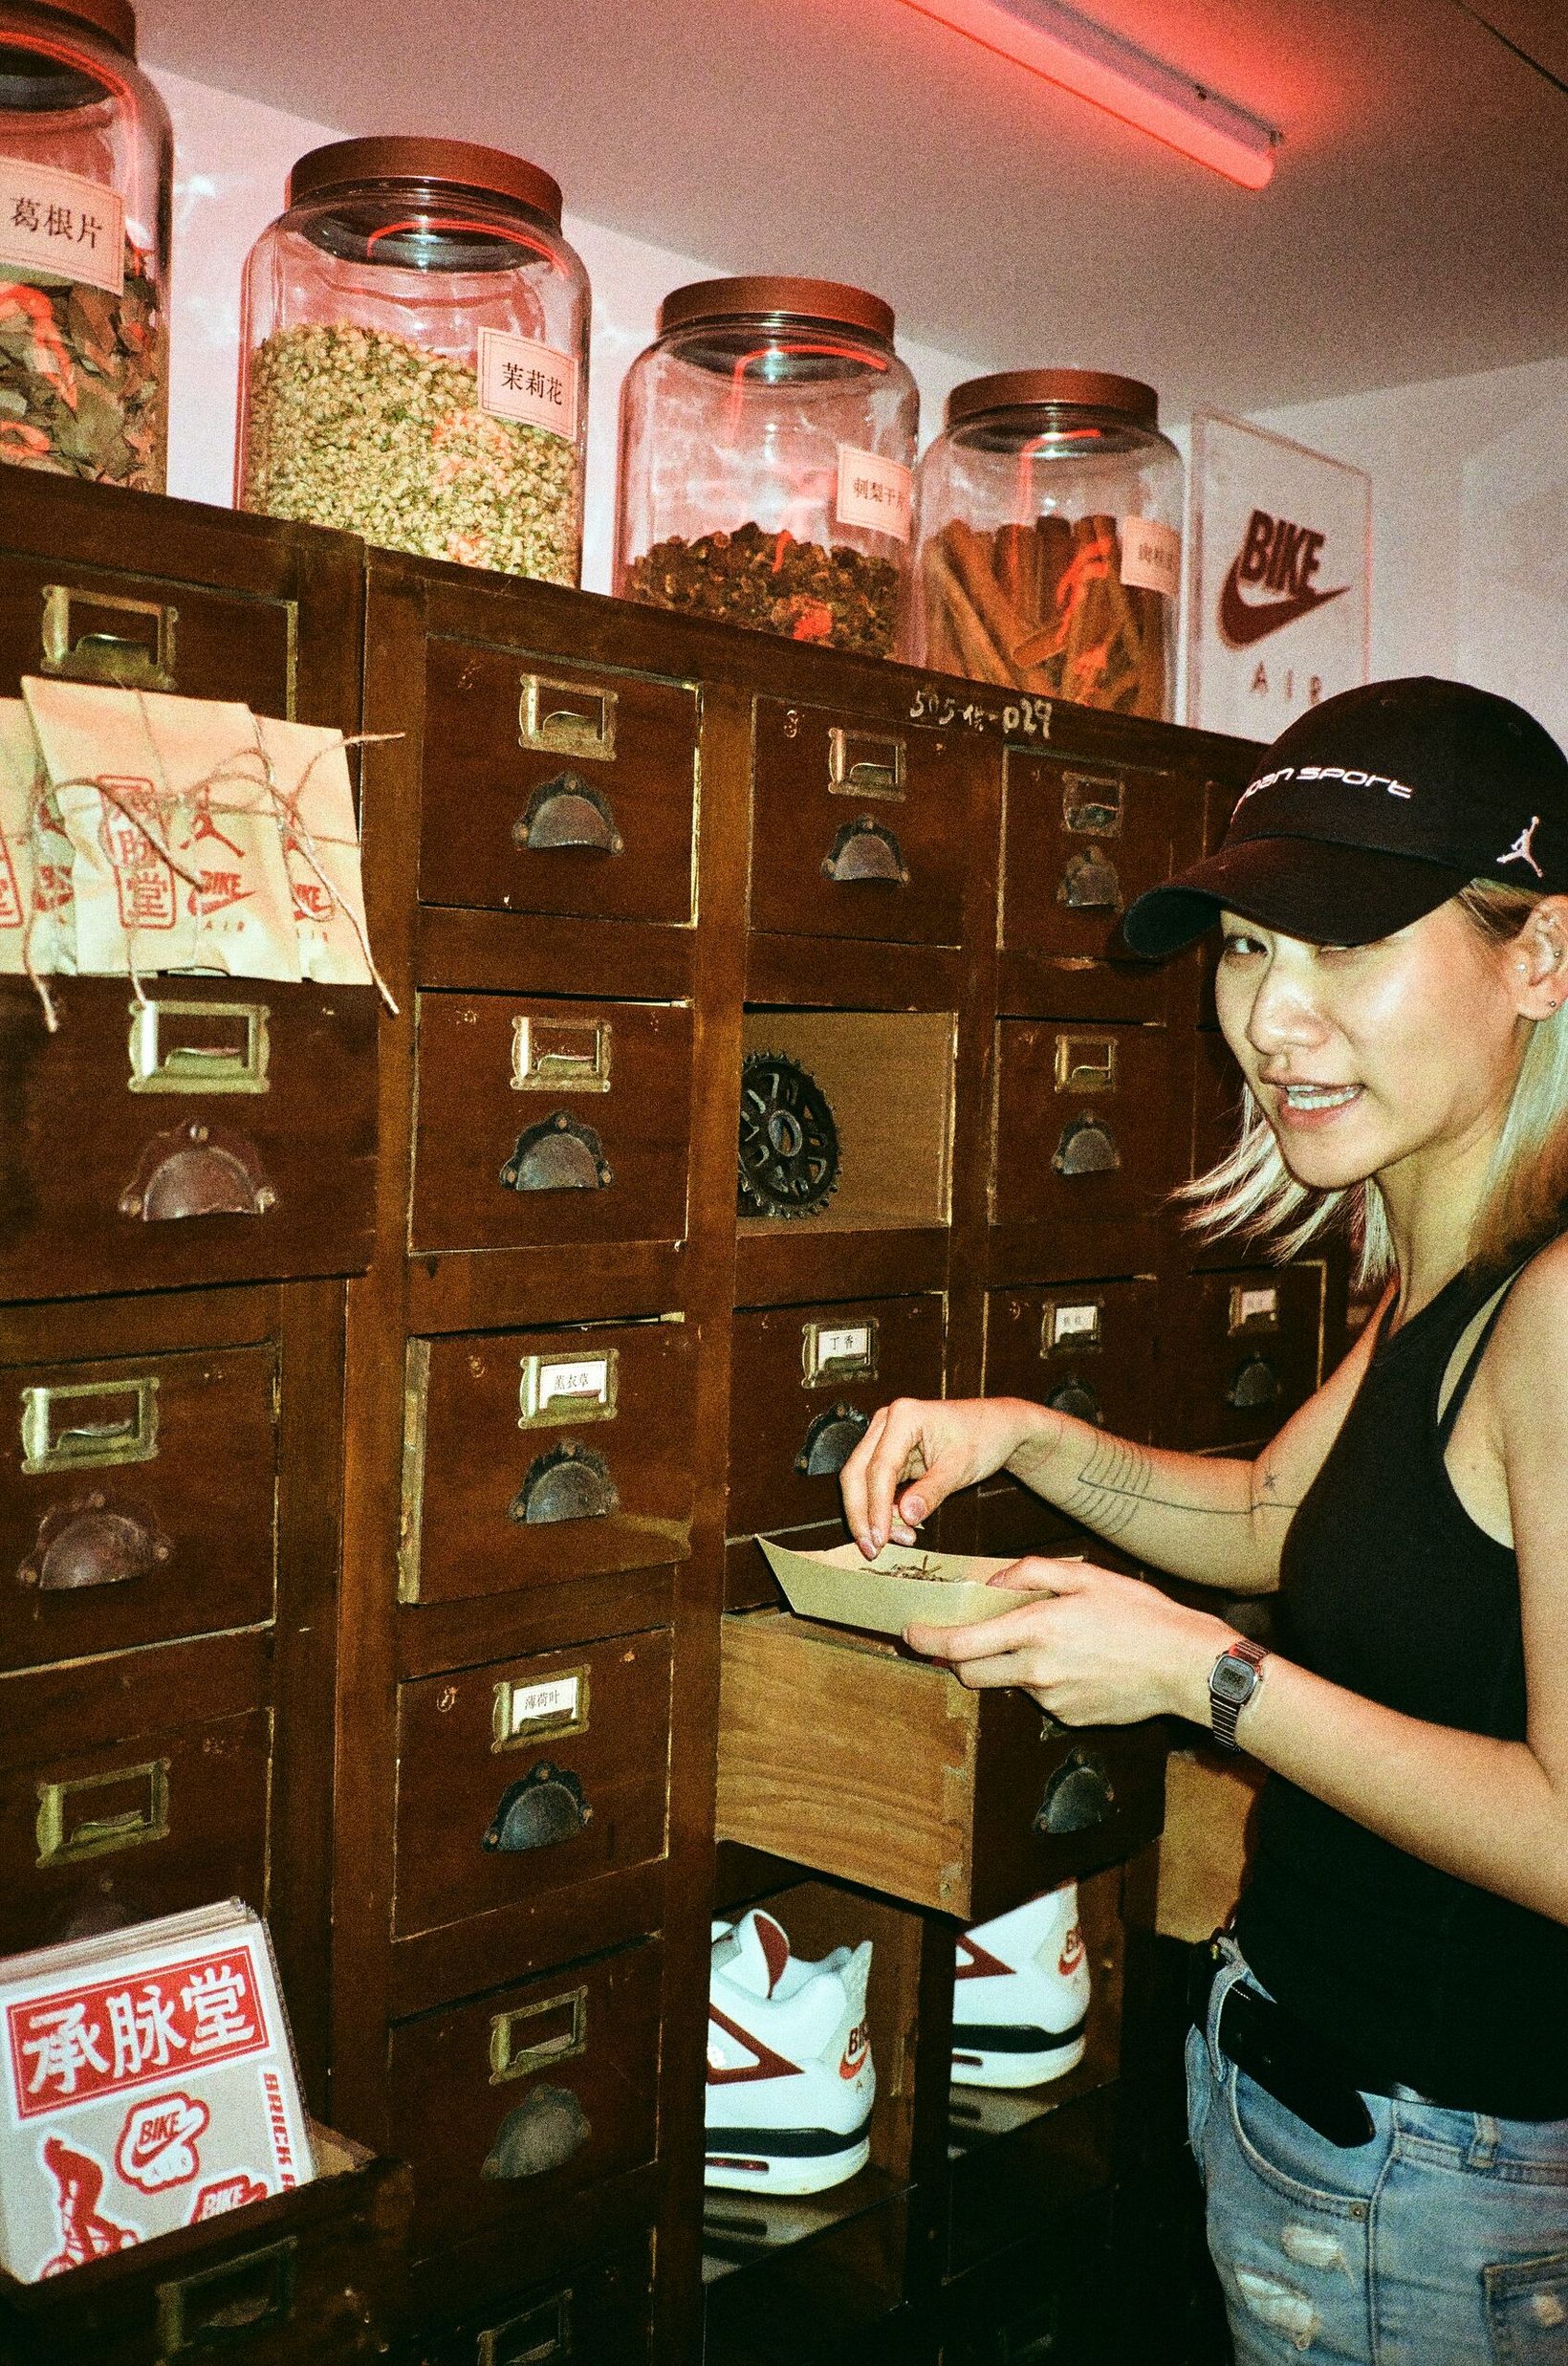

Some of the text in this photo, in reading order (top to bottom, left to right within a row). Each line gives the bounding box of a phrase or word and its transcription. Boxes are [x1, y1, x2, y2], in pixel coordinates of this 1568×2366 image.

[10, 197, 102, 249] 葛根片
[501, 361, 563, 405] 茉莉花
[1240, 509, 1326, 595] BIKE
[1251, 660, 1322, 706] AIR
[829, 1334, 854, 1350] 丁香
[525, 1689, 560, 1710] 薄荷叶
[22, 1964, 255, 2094] 承脉堂
[139, 2110, 181, 2147] BIKE
[264, 2072, 293, 2165] BRICK
